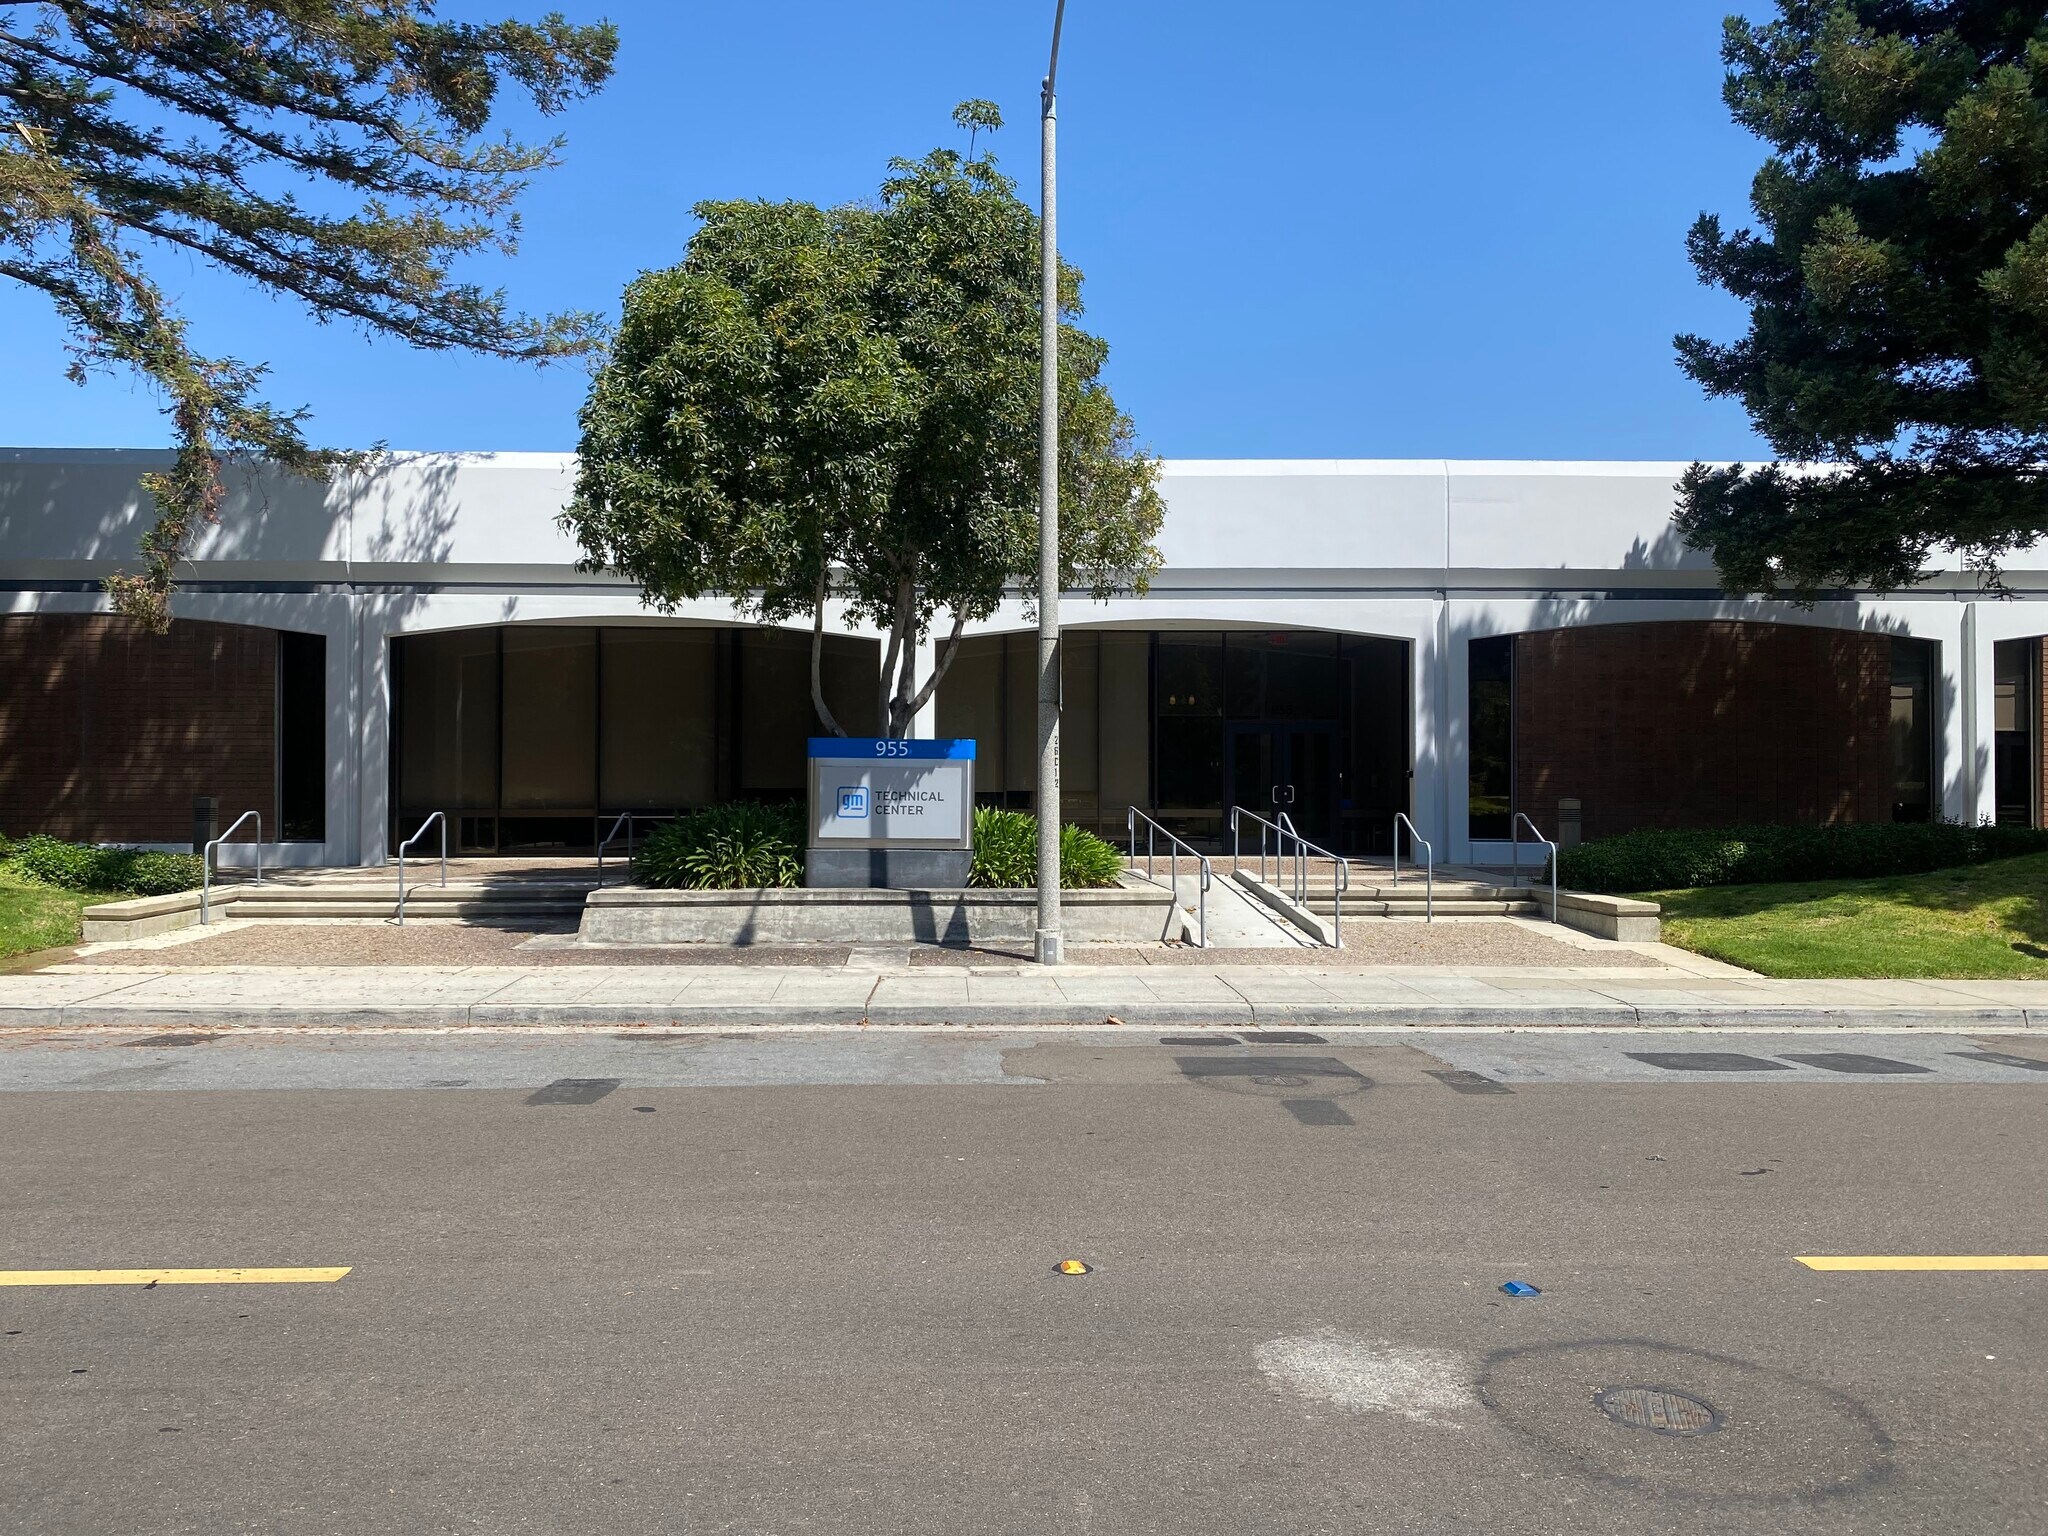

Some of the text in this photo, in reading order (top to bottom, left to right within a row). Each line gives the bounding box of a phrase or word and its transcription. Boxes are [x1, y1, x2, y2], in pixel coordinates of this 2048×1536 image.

[875, 741, 909, 757] 955
[875, 791, 945, 802] TECHNICAL
[875, 805, 924, 815] CENTER
